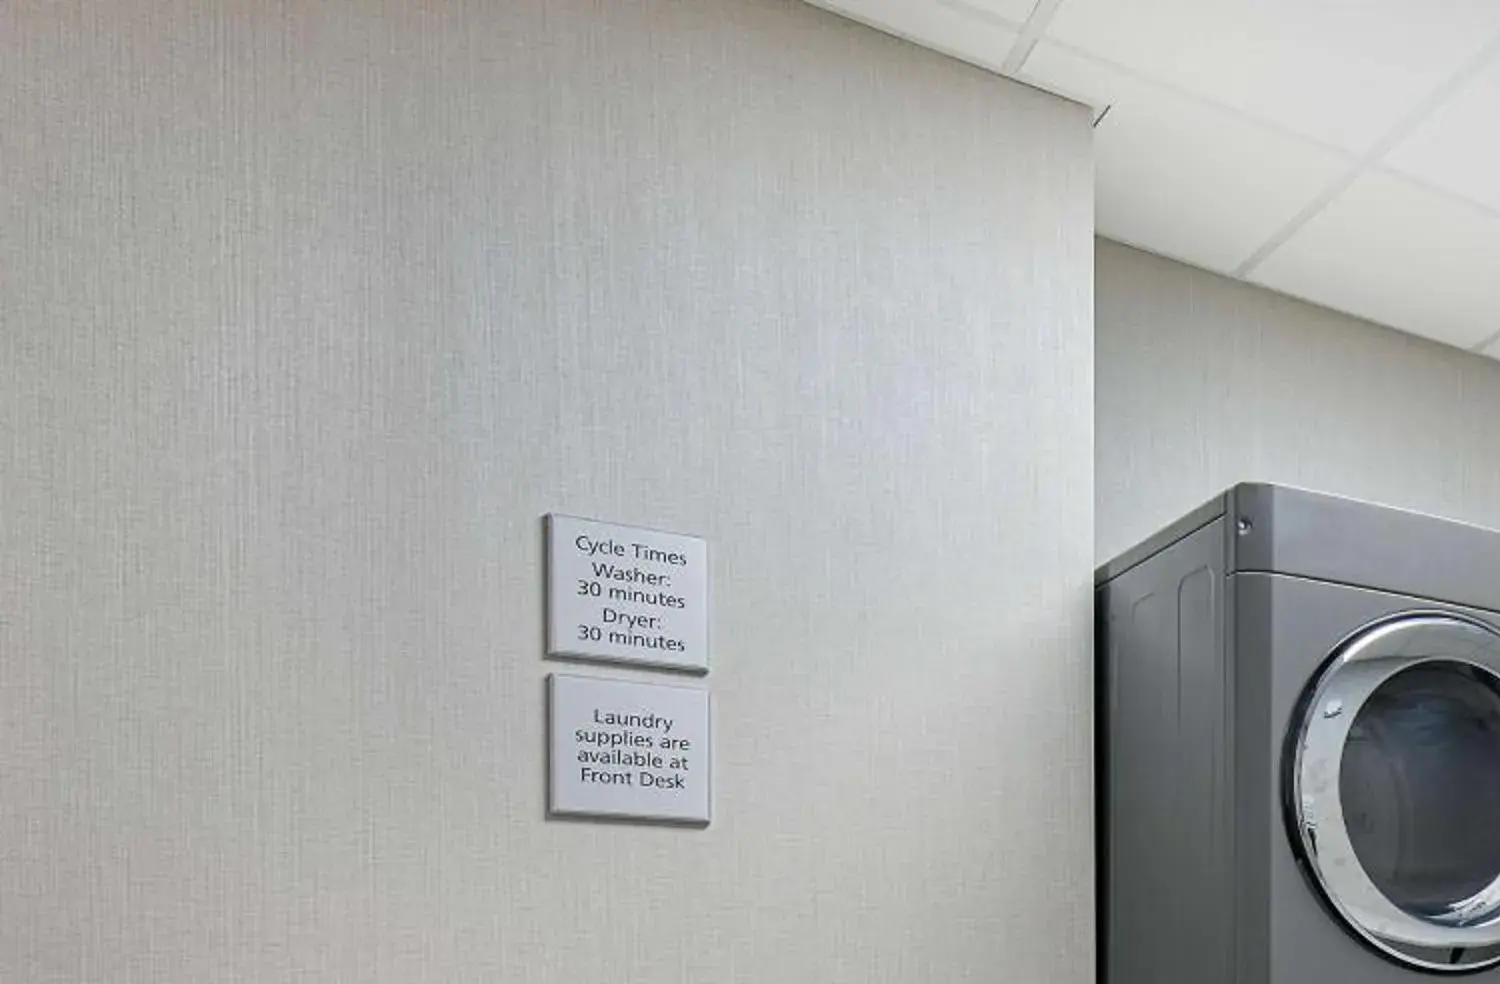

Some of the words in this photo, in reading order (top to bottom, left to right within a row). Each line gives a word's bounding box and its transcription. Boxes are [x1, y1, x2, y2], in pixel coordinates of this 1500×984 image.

[576, 535, 625, 558] Cycle
[632, 543, 687, 566] Times
[592, 562, 671, 588] Washer:
[577, 580, 601, 598] 30
[610, 583, 685, 609] minutes
[603, 608, 662, 630] Dryer:
[577, 625, 601, 642] 30
[610, 628, 685, 652] minutes
[594, 709, 673, 733] Laundry
[576, 729, 653, 749] supplies
[659, 736, 690, 751] are
[577, 749, 663, 768] available
[669, 755, 689, 771] at
[581, 767, 632, 787] Front
[639, 771, 685, 789] Desk
